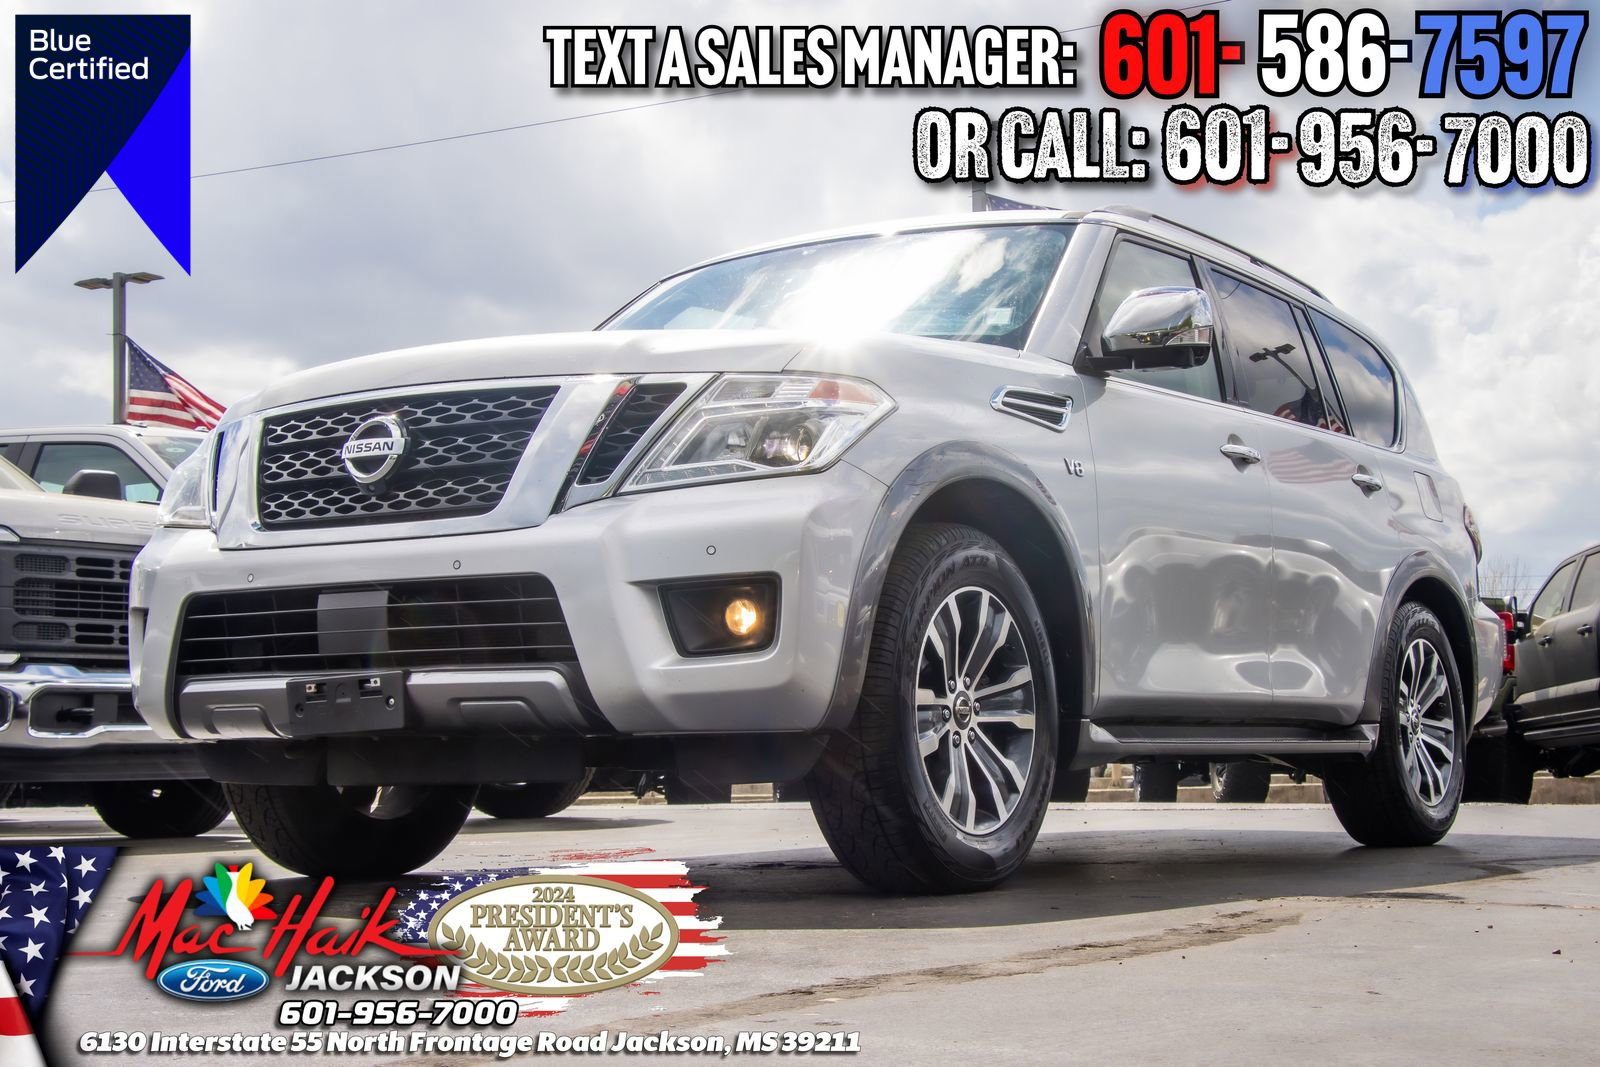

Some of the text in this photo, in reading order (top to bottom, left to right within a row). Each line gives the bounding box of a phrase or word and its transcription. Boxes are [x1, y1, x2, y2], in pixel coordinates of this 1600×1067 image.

[344, 441, 394, 455] NISSAN
[1063, 457, 1085, 478] V8
[57, 512, 158, 530] SUPE
